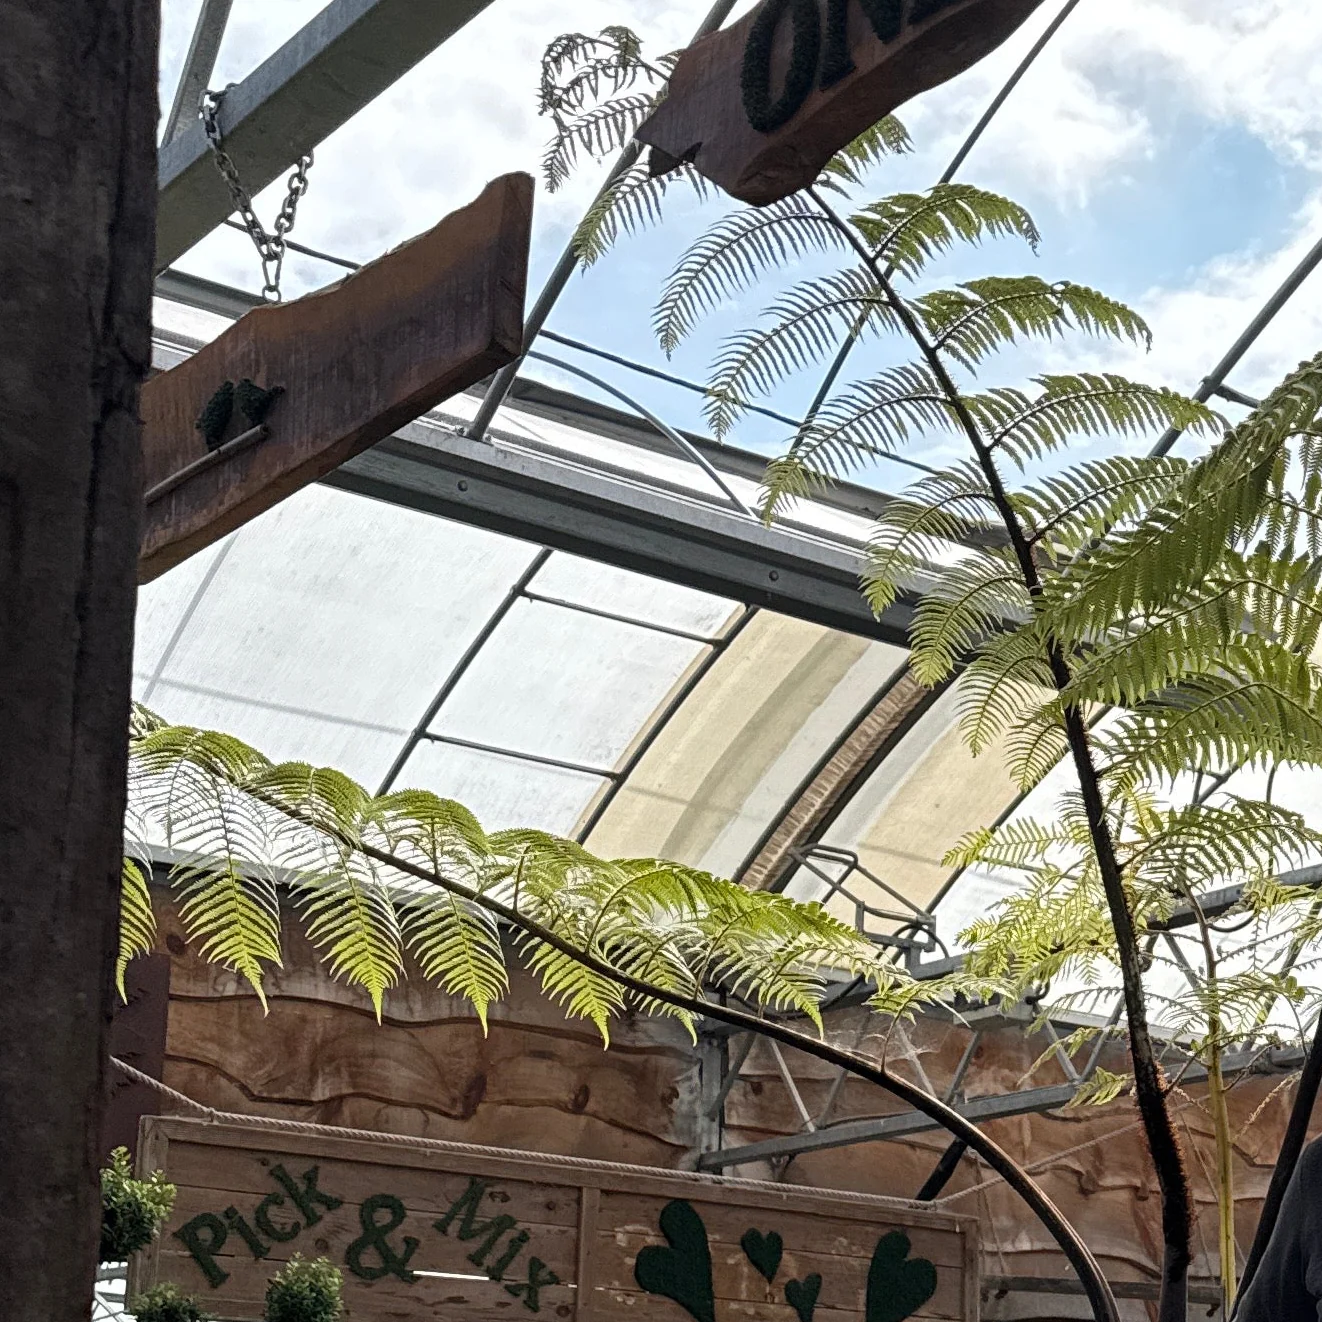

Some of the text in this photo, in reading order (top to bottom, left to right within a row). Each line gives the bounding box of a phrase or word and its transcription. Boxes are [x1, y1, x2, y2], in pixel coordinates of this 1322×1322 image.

[173, 1163, 559, 1312] Pick & Mix
